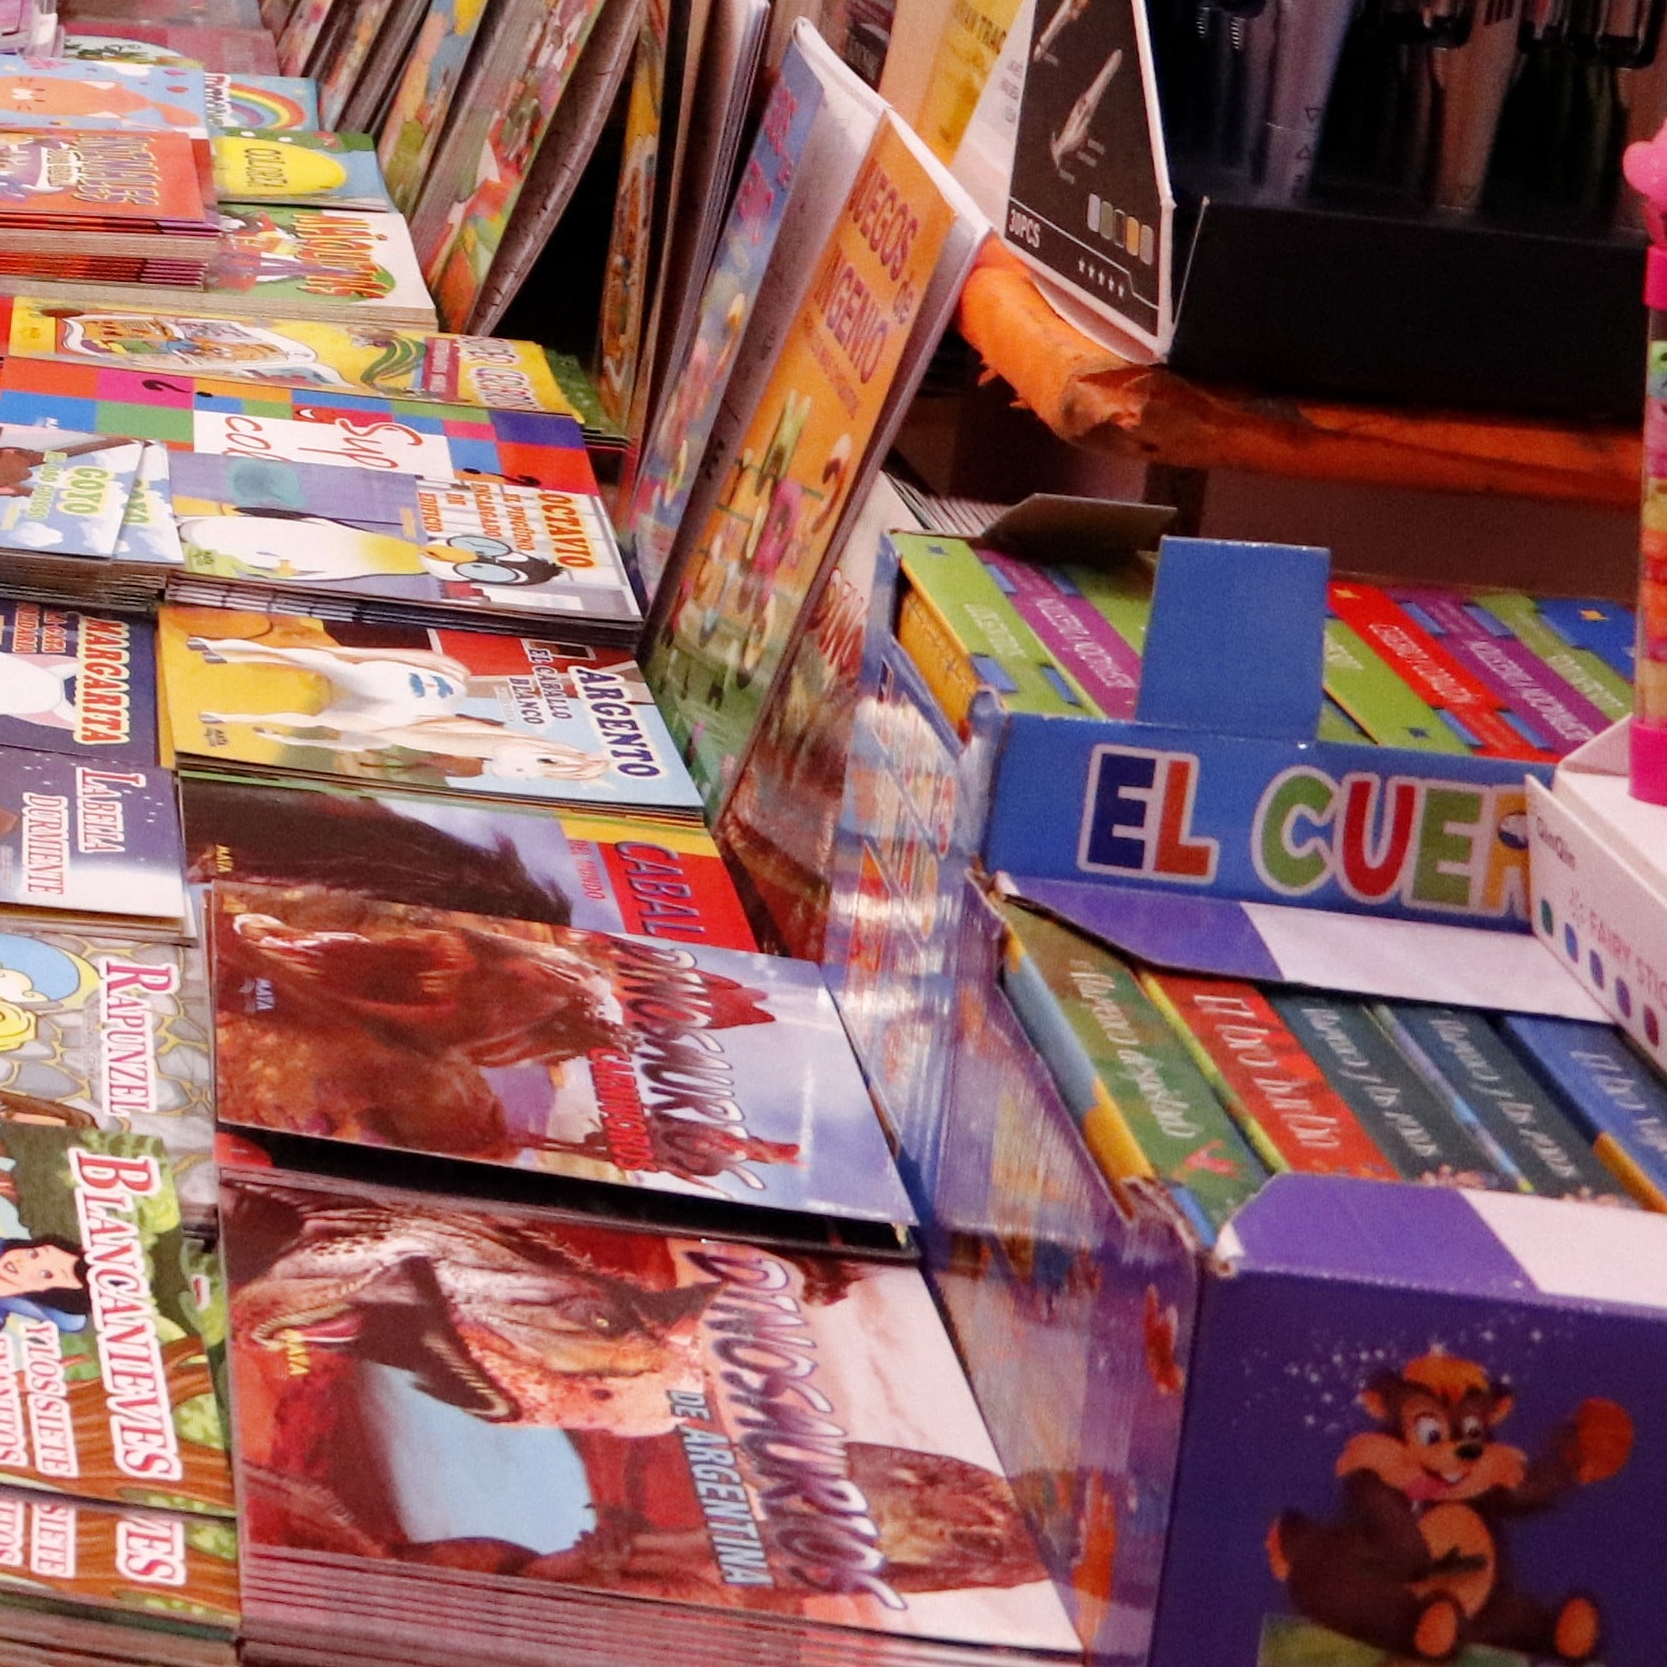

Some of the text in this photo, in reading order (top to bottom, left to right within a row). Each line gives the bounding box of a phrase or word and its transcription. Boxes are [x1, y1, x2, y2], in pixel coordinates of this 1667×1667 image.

[61, 467, 110, 514] GOYO
[537, 493, 595, 568] OCTAVIO
[81, 618, 124, 742] MARGARITA
[509, 677, 545, 725] BLANCO
[534, 666, 573, 720] CABALLO
[575, 669, 661, 777] ARGENTO
[23, 793, 69, 897] DURMIENTE
[1087, 751, 1215, 880] EL
[103, 961, 178, 1115] RAPUNZEL
[77, 1151, 181, 1480] BLANCANIEVES
[25, 1348, 66, 1401] LOS
[31, 1400, 77, 1476] SIETE
[667, 1389, 774, 1587] DE ARGENTINA
